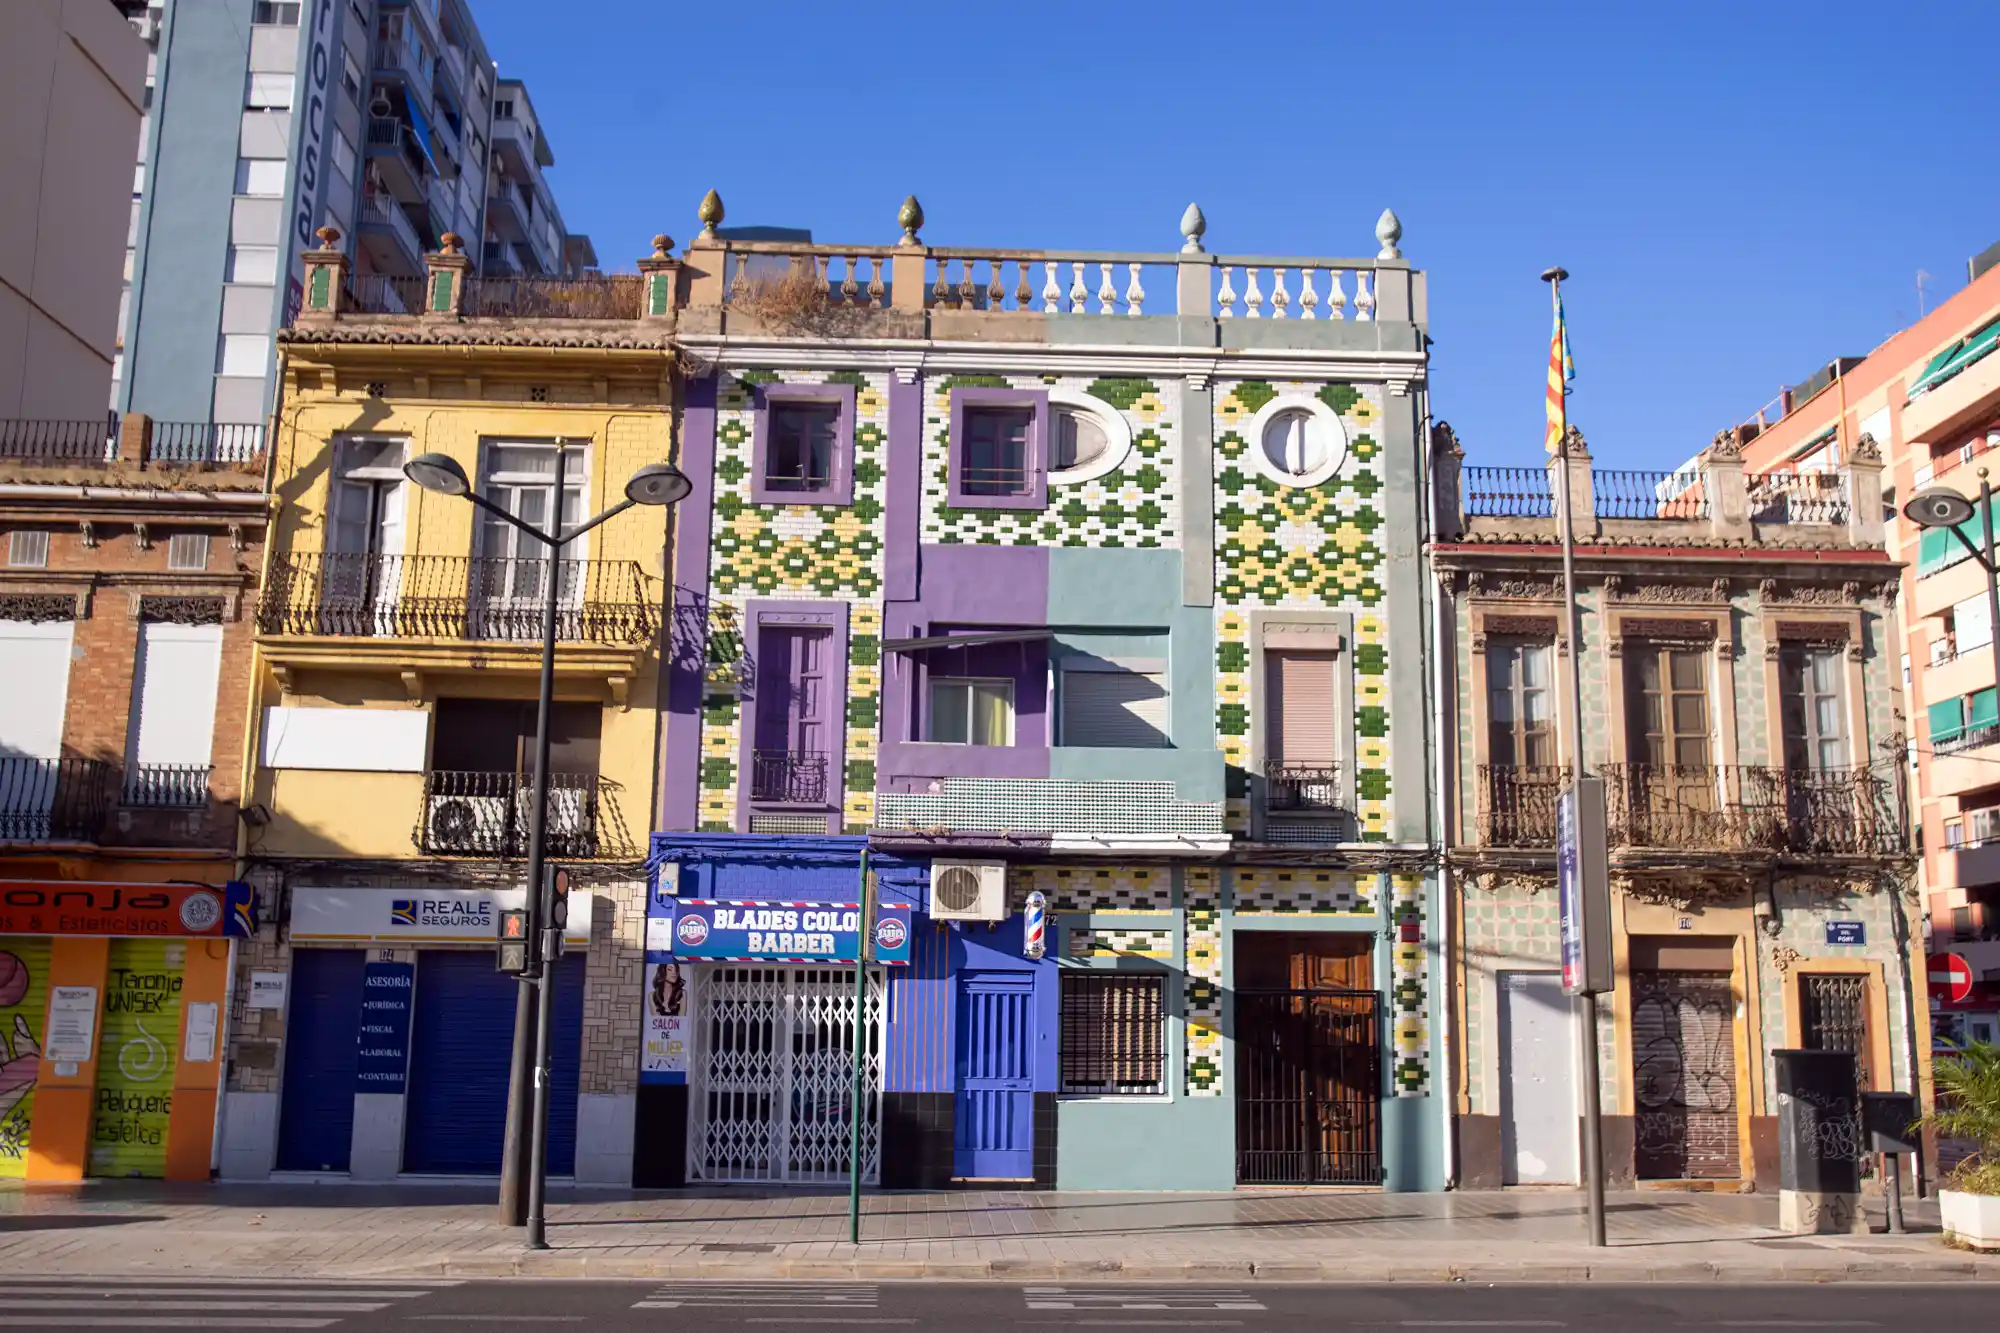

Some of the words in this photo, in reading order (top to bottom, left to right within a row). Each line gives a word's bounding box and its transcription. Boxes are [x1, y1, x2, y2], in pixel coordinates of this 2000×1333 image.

[423, 901, 491, 915] REALE
[59, 914, 168, 932] Esteticistas
[421, 915, 491, 926] SEGUROS
[713, 909, 798, 931] BLADES
[748, 932, 835, 953] BARBER
[380, 949, 393, 960] 174
[110, 968, 184, 1001] Taronja
[366, 975, 411, 987] ASESORÍA
[107, 990, 163, 1013] UNISEX
[367, 1025, 394, 1033] FISCAL
[366, 1049, 402, 1057] LABORAL
[364, 1073, 404, 1081] CONTABLE
